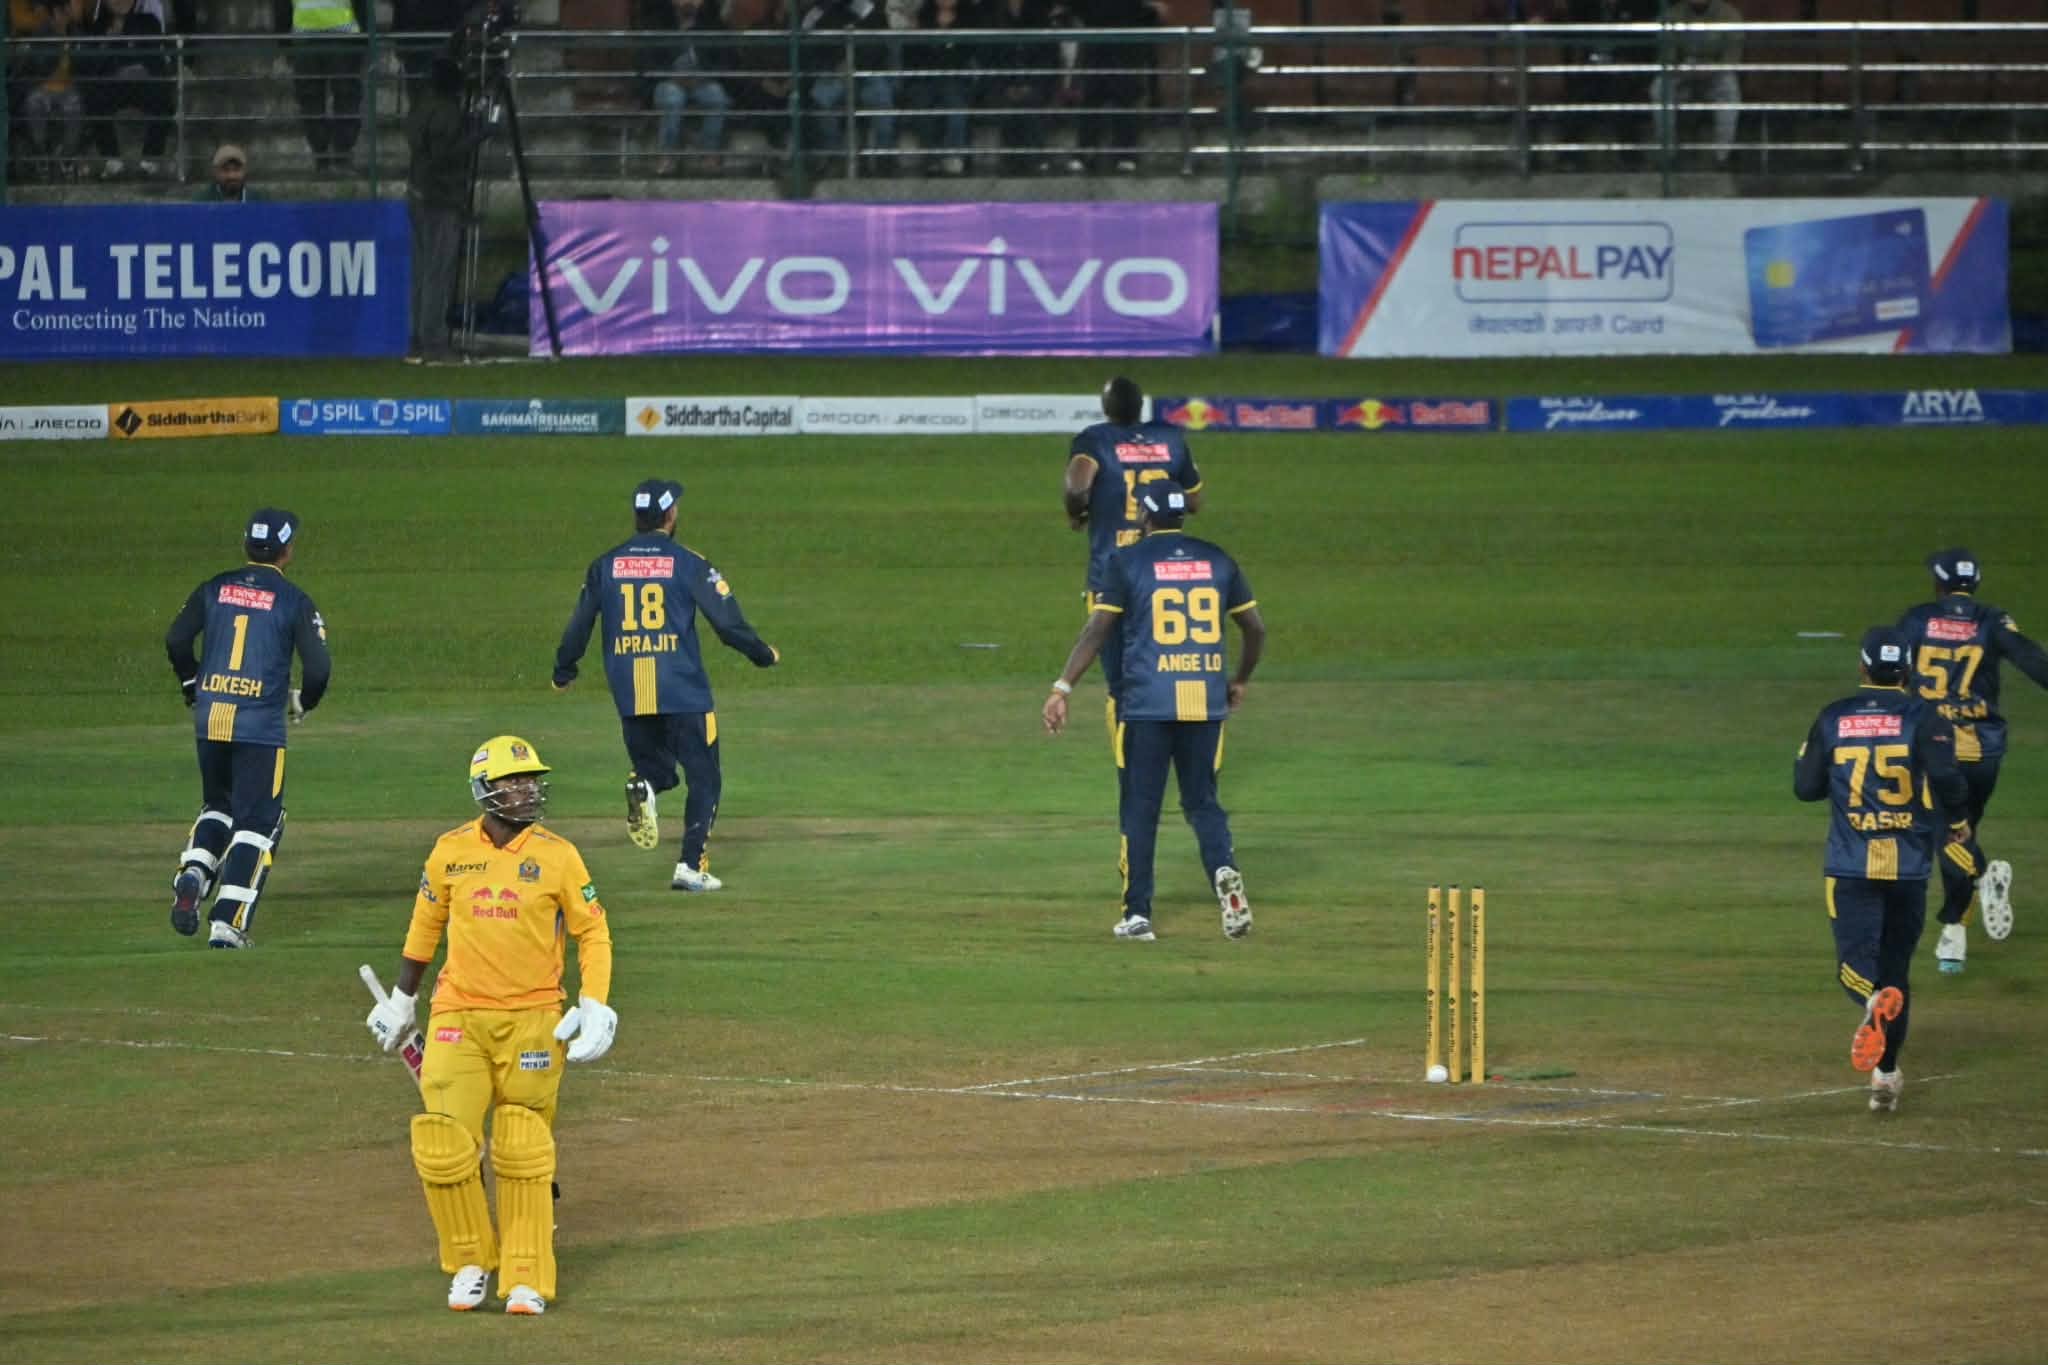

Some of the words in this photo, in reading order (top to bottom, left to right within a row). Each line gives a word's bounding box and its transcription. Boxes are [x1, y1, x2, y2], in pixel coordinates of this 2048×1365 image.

[109, 240, 376, 298] TELECOM
[558, 236, 850, 315] vivo
[894, 236, 1189, 315] vivo
[13, 307, 136, 334] Connecting
[144, 307, 185, 328] The
[193, 306, 266, 328] Nation
[1612, 314, 1664, 334] Card
[323, 403, 364, 422] SPIL
[403, 403, 445, 422] SPIL
[1903, 389, 1984, 416] ARYA
[665, 404, 741, 427] Siddhartha
[743, 404, 792, 431] Capital
[620, 583, 665, 632] 18
[1151, 586, 1222, 646] 69
[228, 614, 249, 672] 1
[614, 634, 679, 656] APRAJIT
[1157, 653, 1202, 673] ANGE
[1204, 653, 1222, 672] LO
[1916, 645, 1985, 701] 57
[201, 674, 263, 698] LOKESH
[1833, 744, 1913, 808] 75
[445, 861, 488, 873] Marvel
[472, 905, 494, 918] Red
[495, 906, 518, 920] Bull
